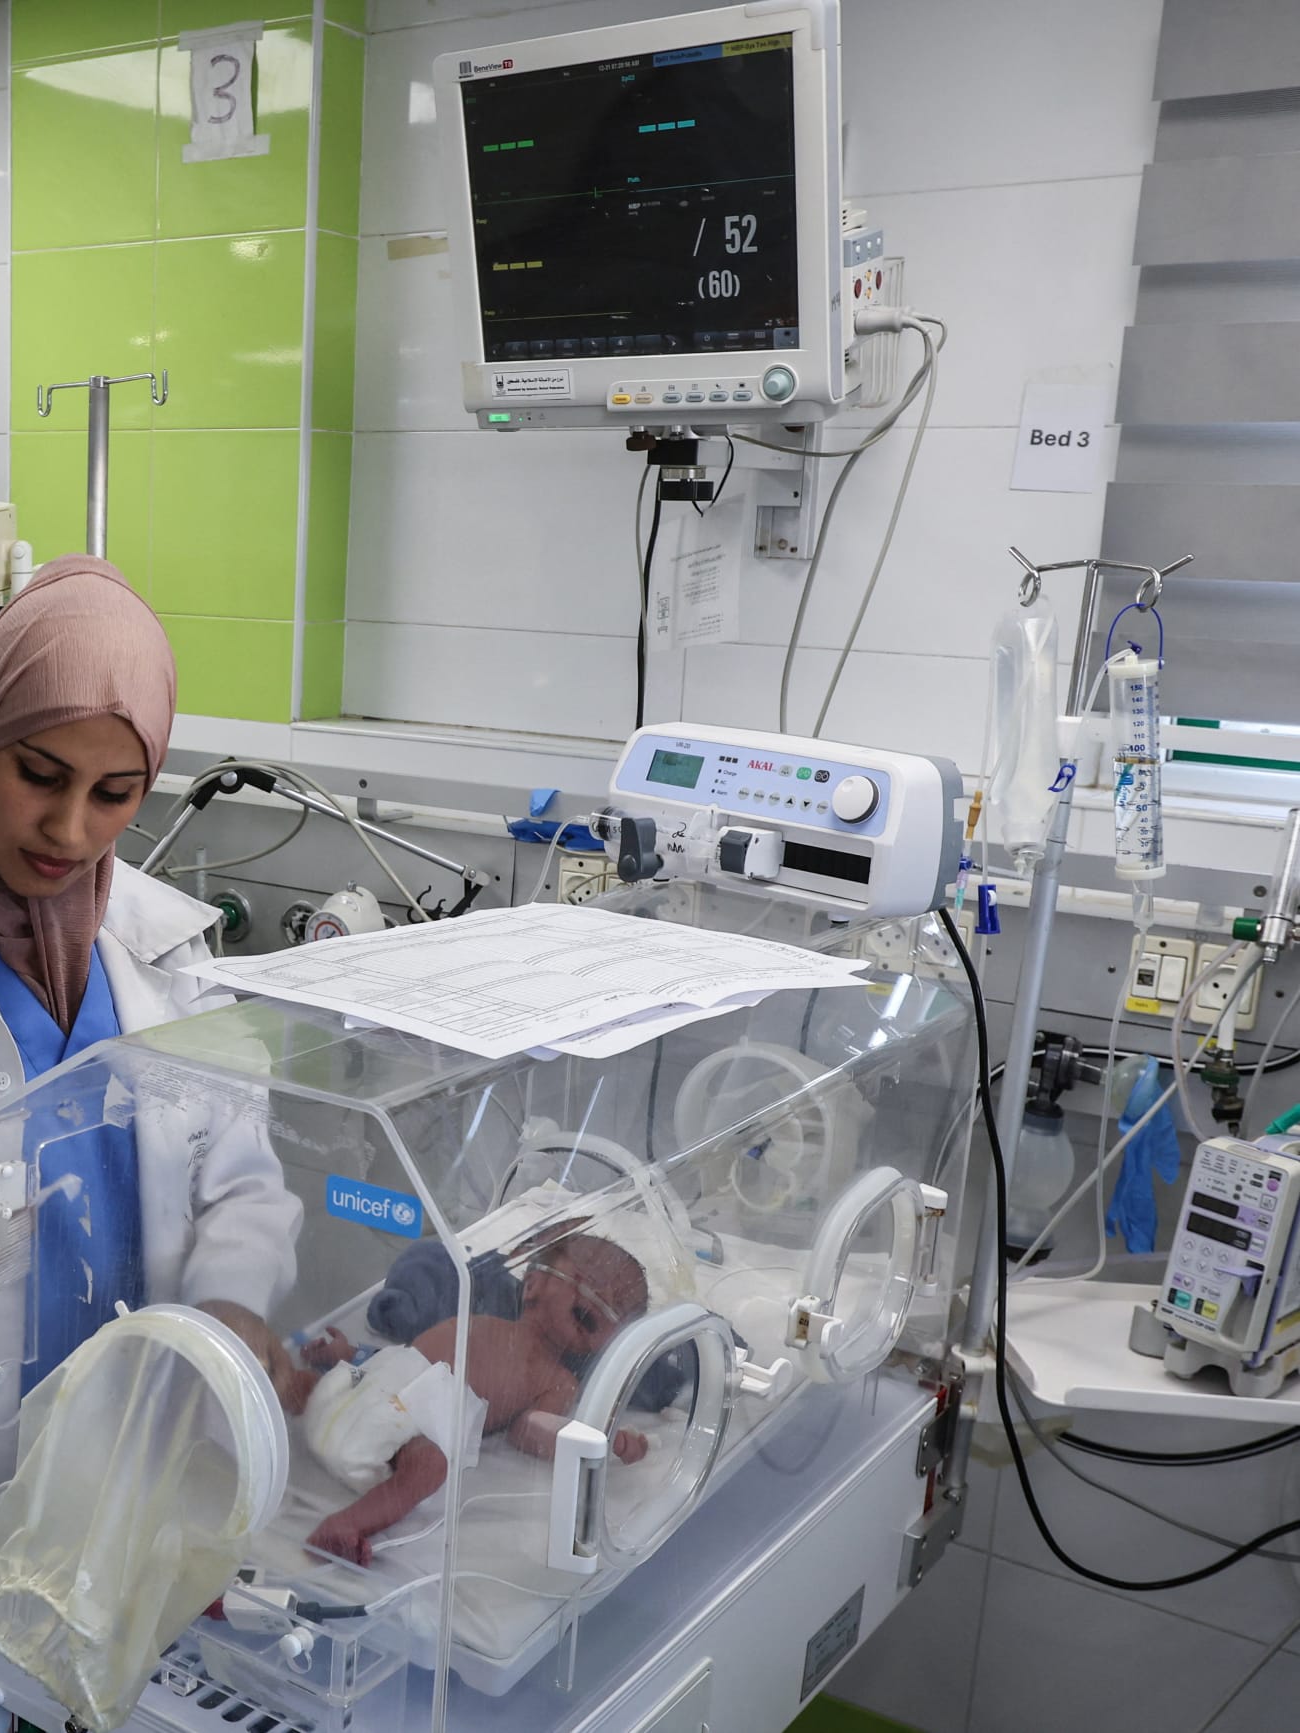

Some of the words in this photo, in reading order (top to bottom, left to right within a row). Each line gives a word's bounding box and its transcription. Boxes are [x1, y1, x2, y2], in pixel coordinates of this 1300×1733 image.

[208, 54, 240, 124] 3
[724, 214, 758, 254] 52
[1030, 429, 1072, 447] Bed
[1077, 431, 1090, 448] 3
[1130, 744, 1145, 752] 100
[1136, 804, 1148, 812] 50
[332, 1190, 391, 1219] unicef
